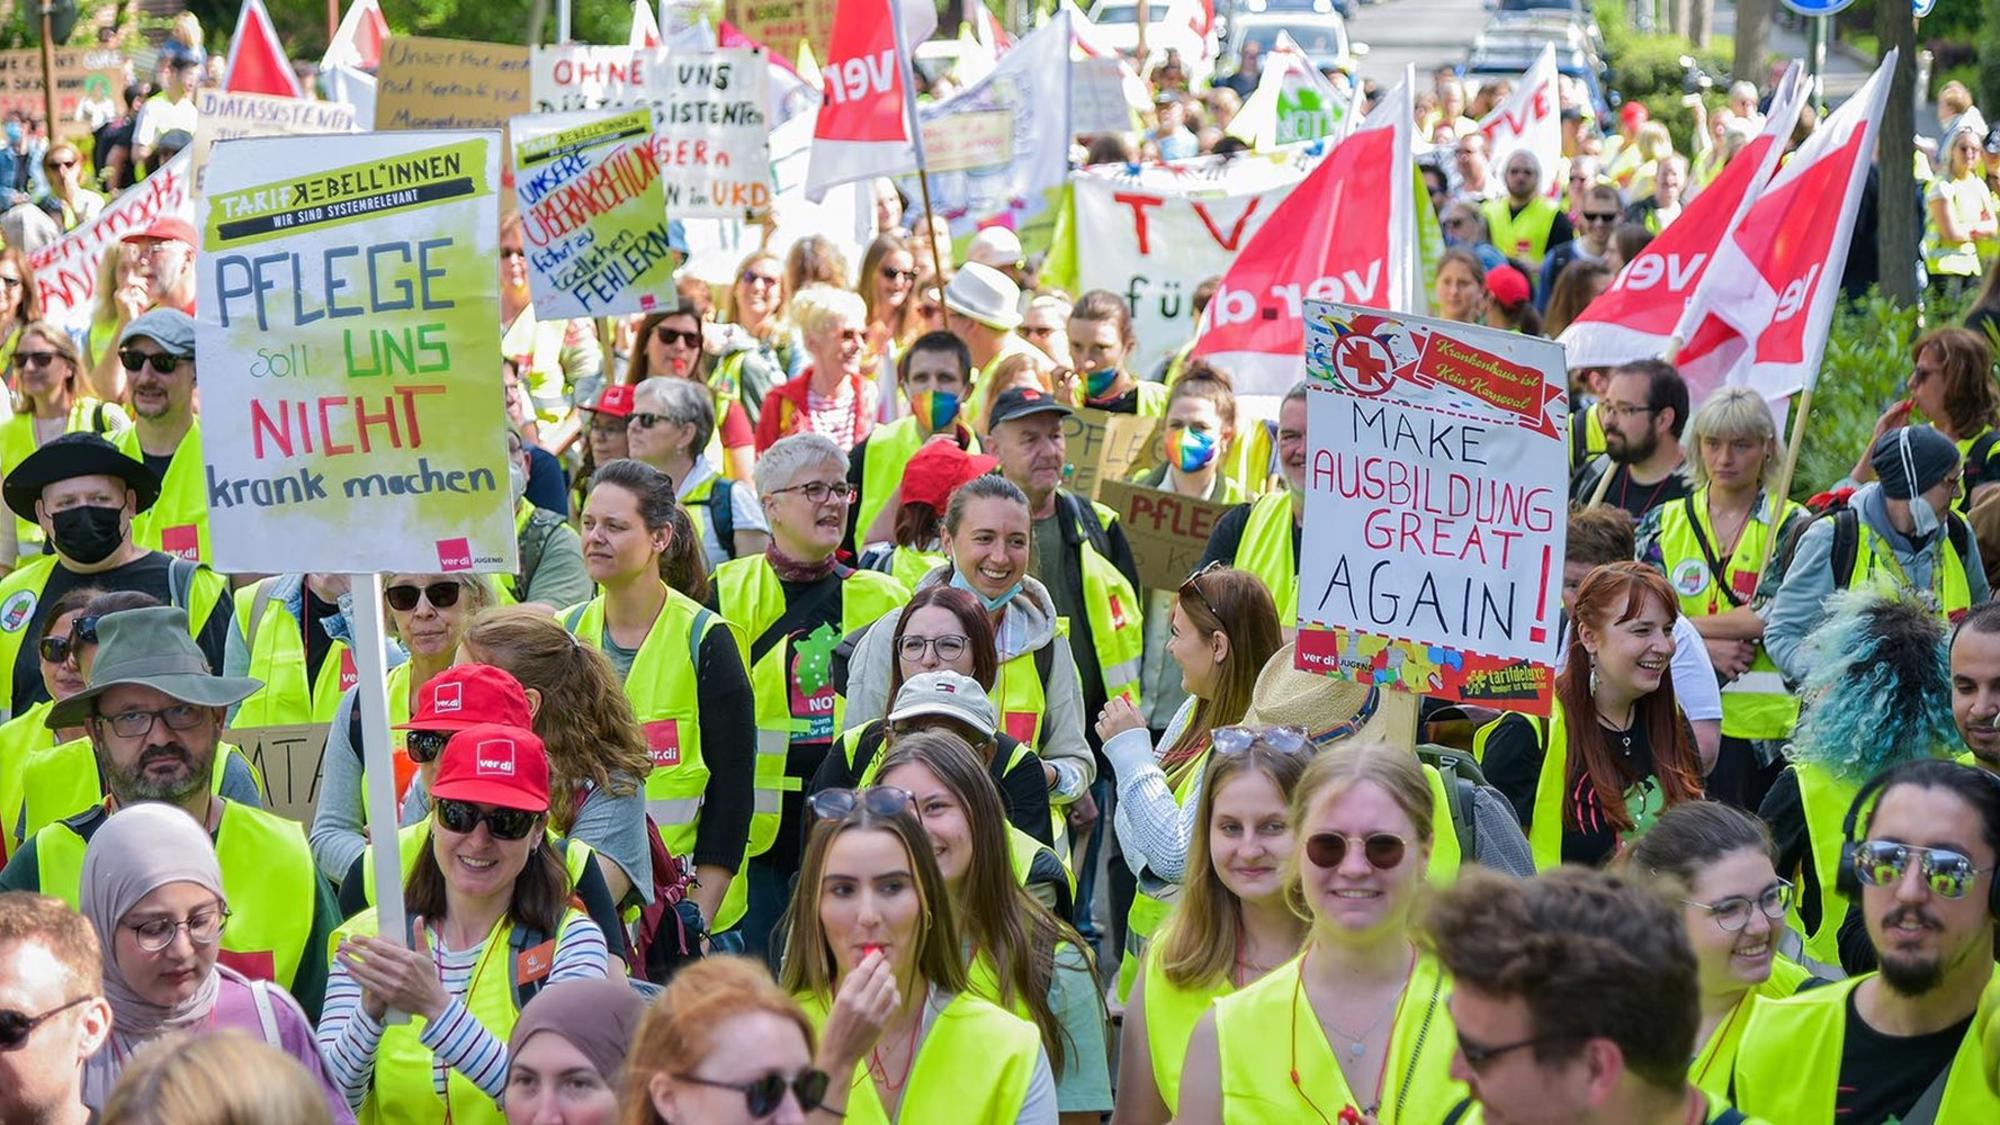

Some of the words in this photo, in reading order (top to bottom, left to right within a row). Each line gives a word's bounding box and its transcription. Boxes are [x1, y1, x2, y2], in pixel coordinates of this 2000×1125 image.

[554, 59, 644, 86] OHNE
[678, 64, 731, 90] UNS
[519, 149, 592, 204] UNSERE
[713, 181, 769, 207] UKD
[273, 213, 293, 228] WIR
[297, 208, 322, 223] SIND
[328, 188, 419, 217] SYSTEMRELEVANT
[215, 237, 455, 331] PFLEGE
[572, 222, 670, 312] FEHLERN
[1126, 275, 1195, 319] fü
[343, 323, 450, 377] UNS
[1436, 339, 1518, 381] Krankenhaus
[1520, 374, 1540, 387] ist
[1469, 377, 1531, 409] Karneval
[250, 385, 446, 459] NICHT
[1353, 401, 1488, 465] MAKE
[206, 464, 328, 508] krank
[343, 457, 496, 499] machen
[1313, 449, 1553, 532] AUSBILDUNG
[1364, 508, 1524, 570] GREAT
[1339, 659, 1375, 672] JUGEND
[1488, 665, 1546, 685] tarifdeluxe
